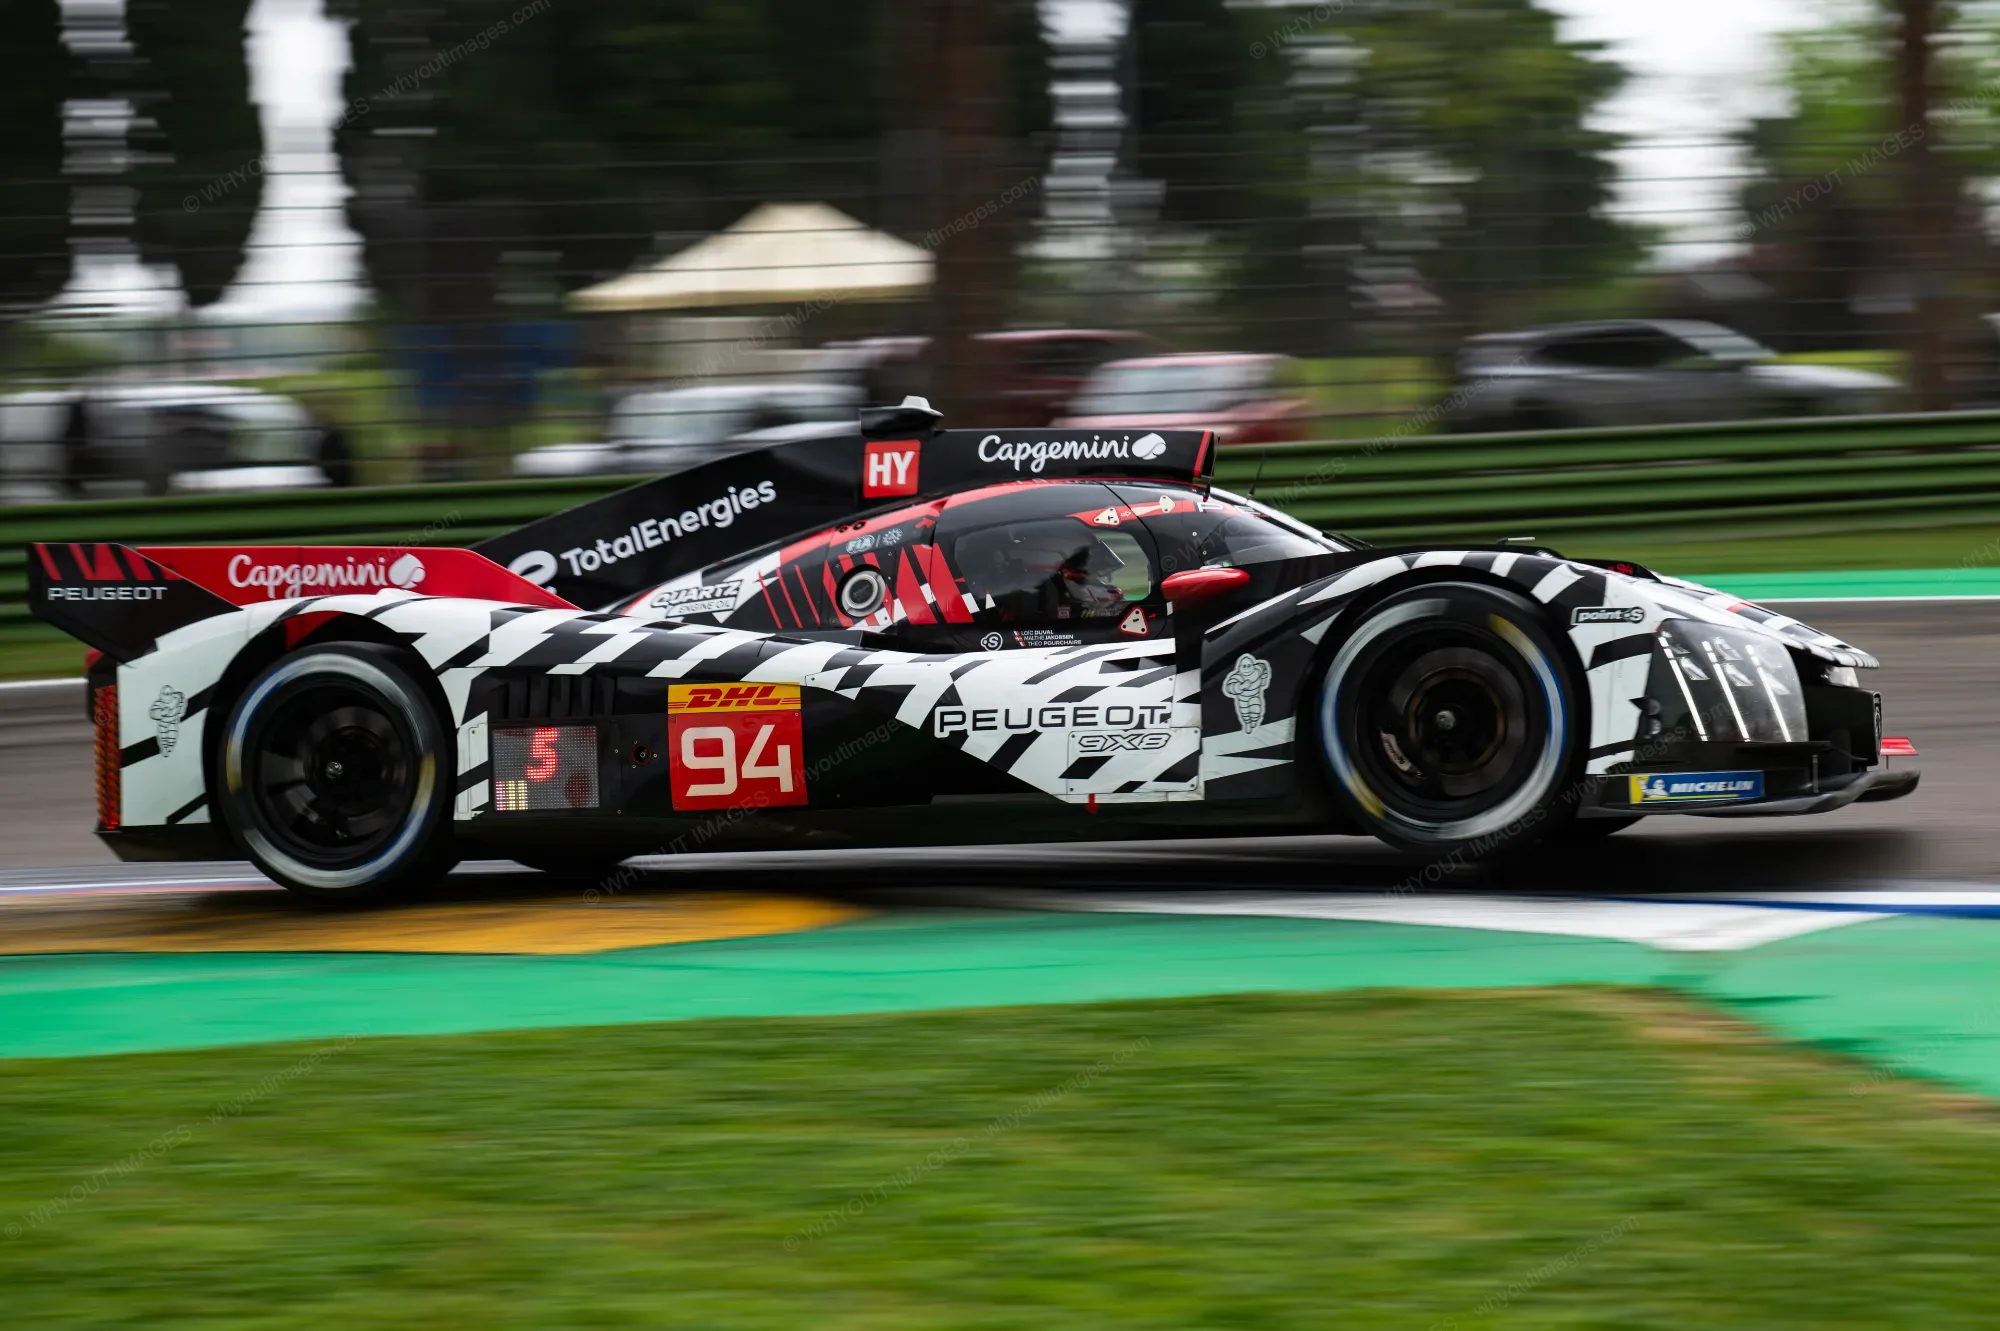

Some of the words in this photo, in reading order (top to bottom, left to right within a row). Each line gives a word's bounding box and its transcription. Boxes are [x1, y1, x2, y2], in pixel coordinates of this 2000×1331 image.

[978, 434, 1130, 473] Capgemini
[868, 451, 915, 487] HY
[560, 480, 777, 576] TotalEnergies
[847, 537, 873, 552] FIA
[227, 554, 387, 598] Capgemini
[48, 586, 167, 601] PEUGEOT
[650, 581, 741, 608] QUARTZ
[1578, 609, 1623, 622] point
[686, 686, 777, 708] DHL
[939, 705, 1167, 732] PEUGEOT
[526, 727, 560, 782] 5
[1078, 732, 1172, 752] 9X8
[681, 724, 793, 796] 94
[1670, 781, 1754, 793] MICHELIN
